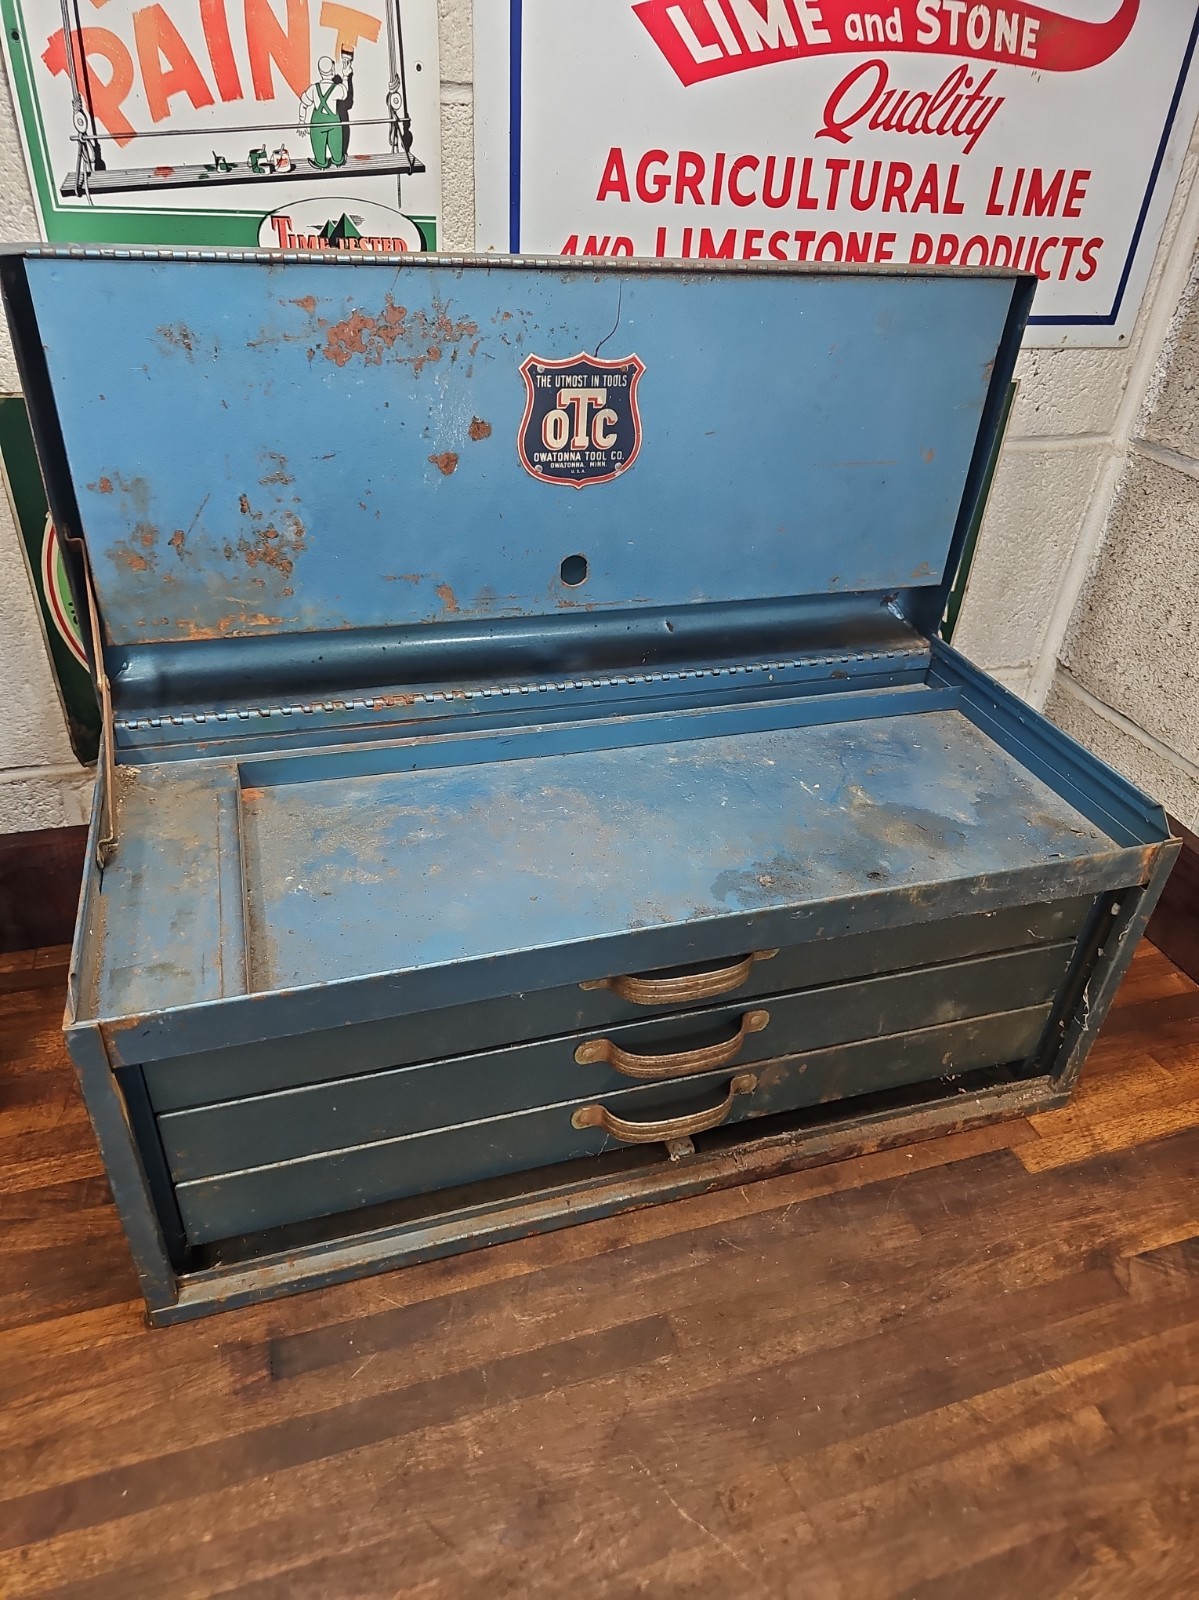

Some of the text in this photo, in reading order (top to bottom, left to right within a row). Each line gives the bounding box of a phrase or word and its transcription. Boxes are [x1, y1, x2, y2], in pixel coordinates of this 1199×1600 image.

[666, 0, 1040, 64] LIME and STONE
[41, 0, 382, 148] PAINT
[815, 59, 1005, 154] Quality
[596, 147, 1091, 218] AGRICULTURAL LIME
[655, 226, 897, 263] LIMESTONE
[909, 232, 1104, 282] PRODUCTS
[536, 375, 628, 388] THE UTMOST IN TOOLS
[533, 451, 625, 462] OWATONNA TOOL CO.
